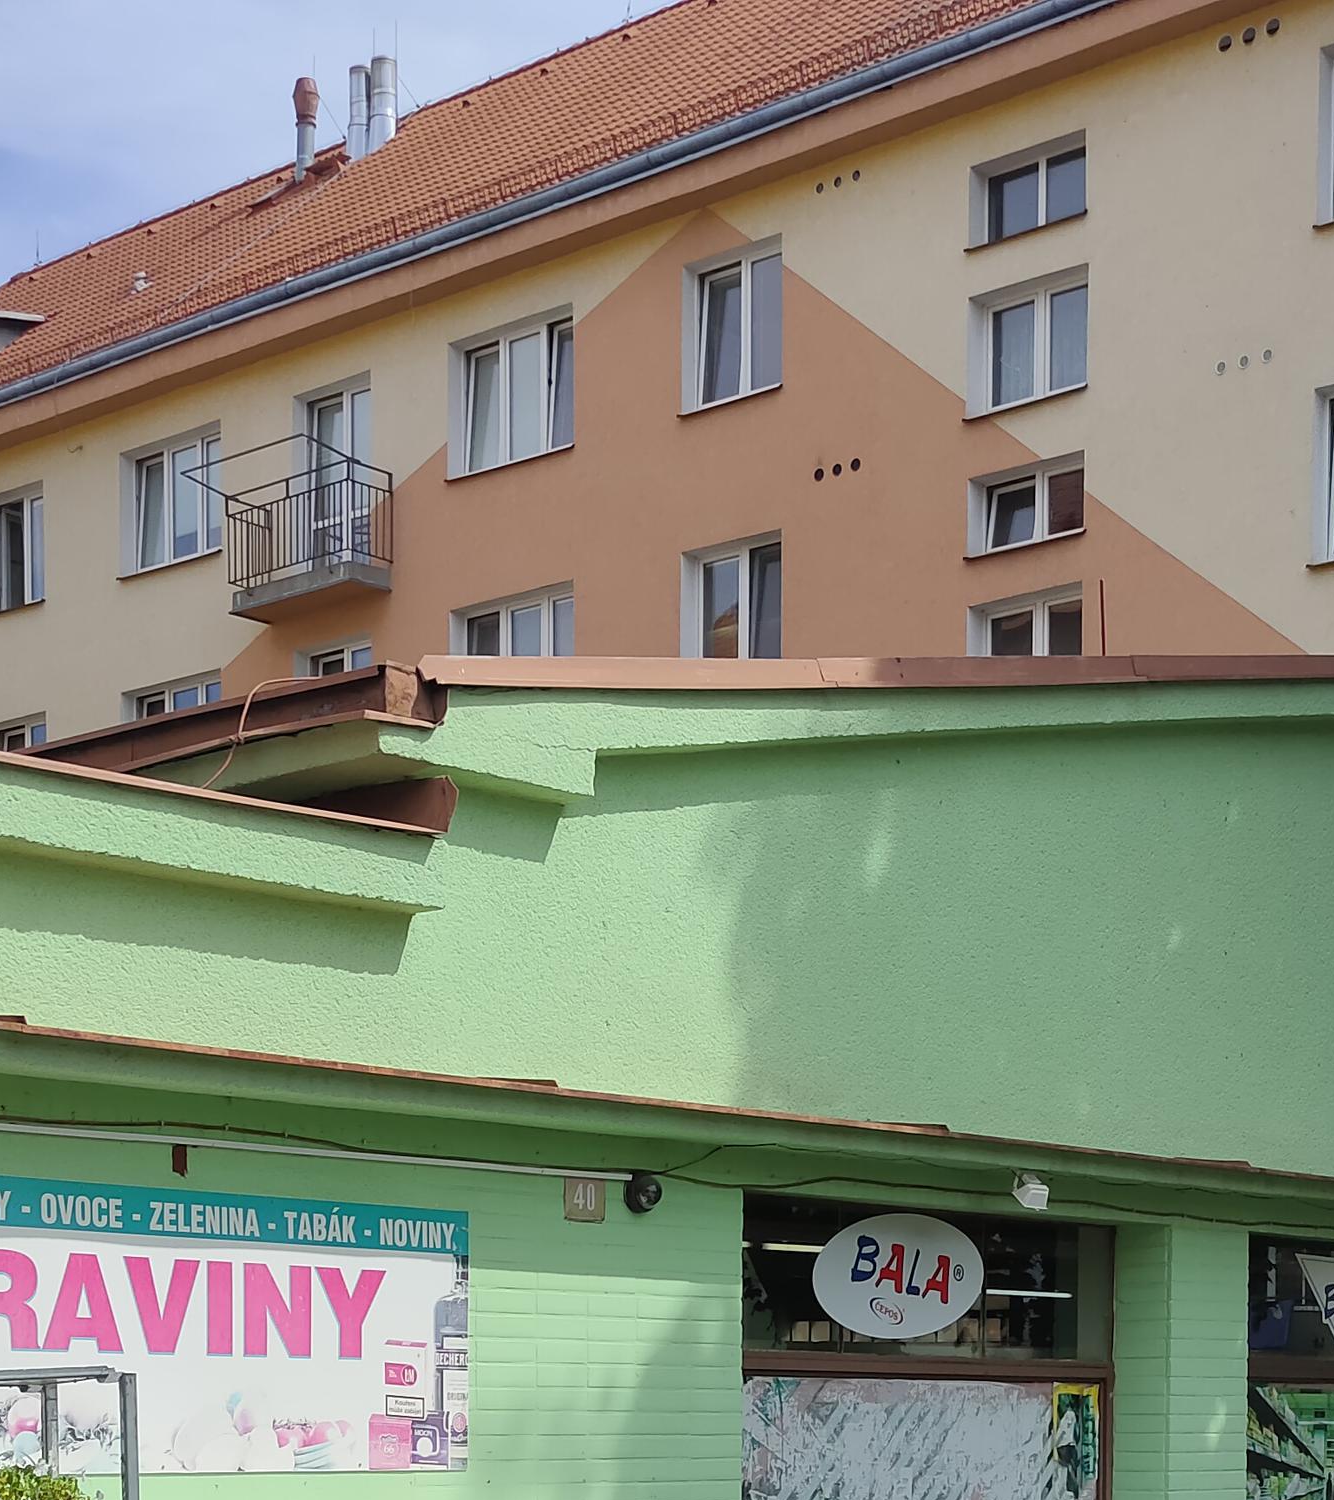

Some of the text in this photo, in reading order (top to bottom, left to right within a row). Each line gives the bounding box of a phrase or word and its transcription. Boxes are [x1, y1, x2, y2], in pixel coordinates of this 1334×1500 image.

[40, 1193, 123, 1229] OVOCE
[149, 1201, 260, 1238] ZELENINA
[283, 1206, 357, 1244] TABÁK
[379, 1217, 456, 1251] NOVINY
[573, 1183, 596, 1211] 40
[851, 1235, 951, 1305] BALA
